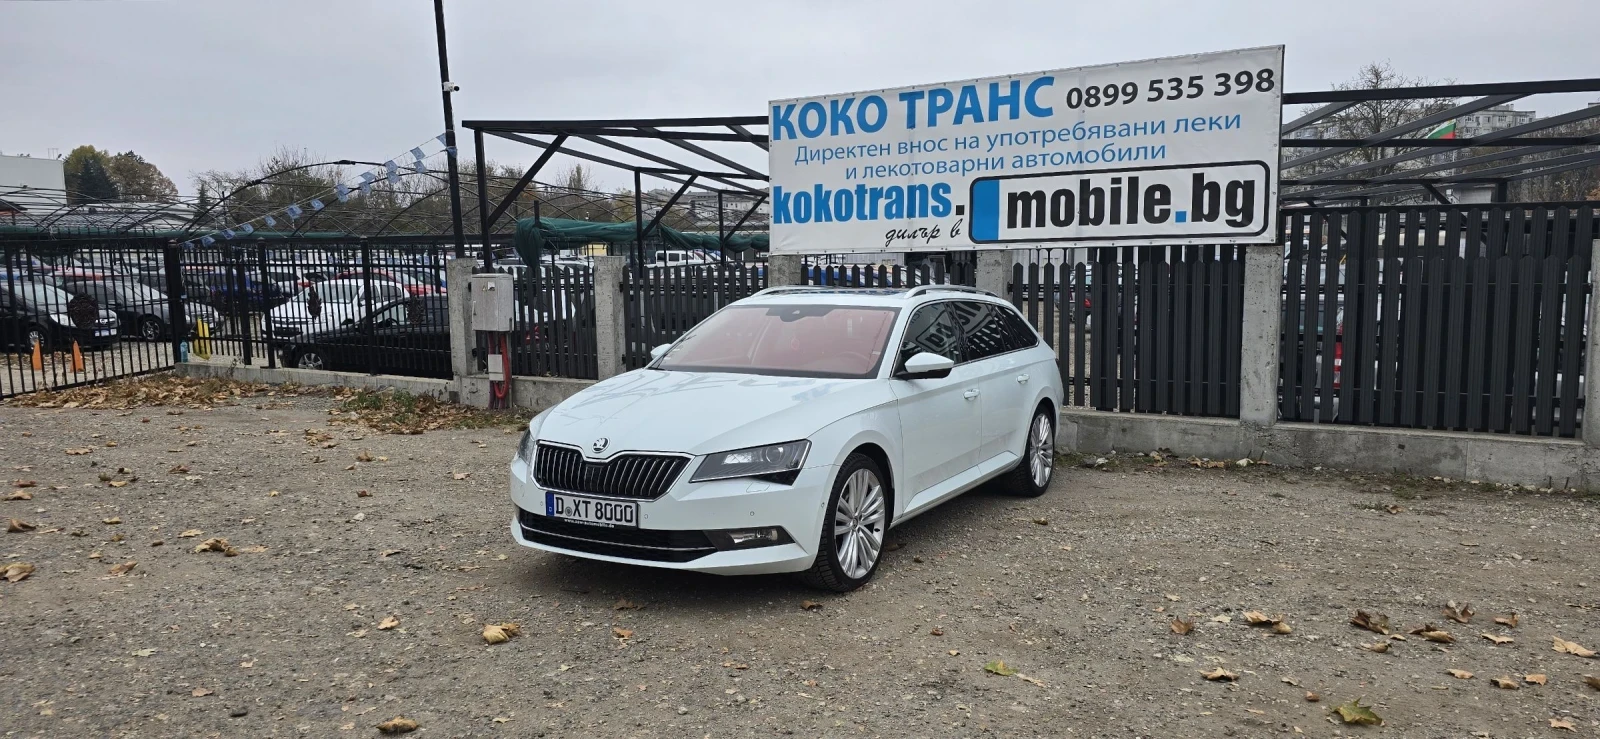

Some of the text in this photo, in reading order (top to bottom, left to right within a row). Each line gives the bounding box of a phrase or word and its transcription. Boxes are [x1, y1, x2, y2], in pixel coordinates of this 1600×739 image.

[772, 76, 1055, 141] КОКО ТРАНС
[1066, 68, 1275, 109] 0899 535 398
[795, 113, 1241, 166] Директен внос на употребявани леки
[846, 142, 1166, 180] и лекотоварни автомобили
[1007, 173, 1255, 228] mobile.bg
[885, 218, 963, 247] дилър в
[555, 496, 634, 523] D XT 8000
